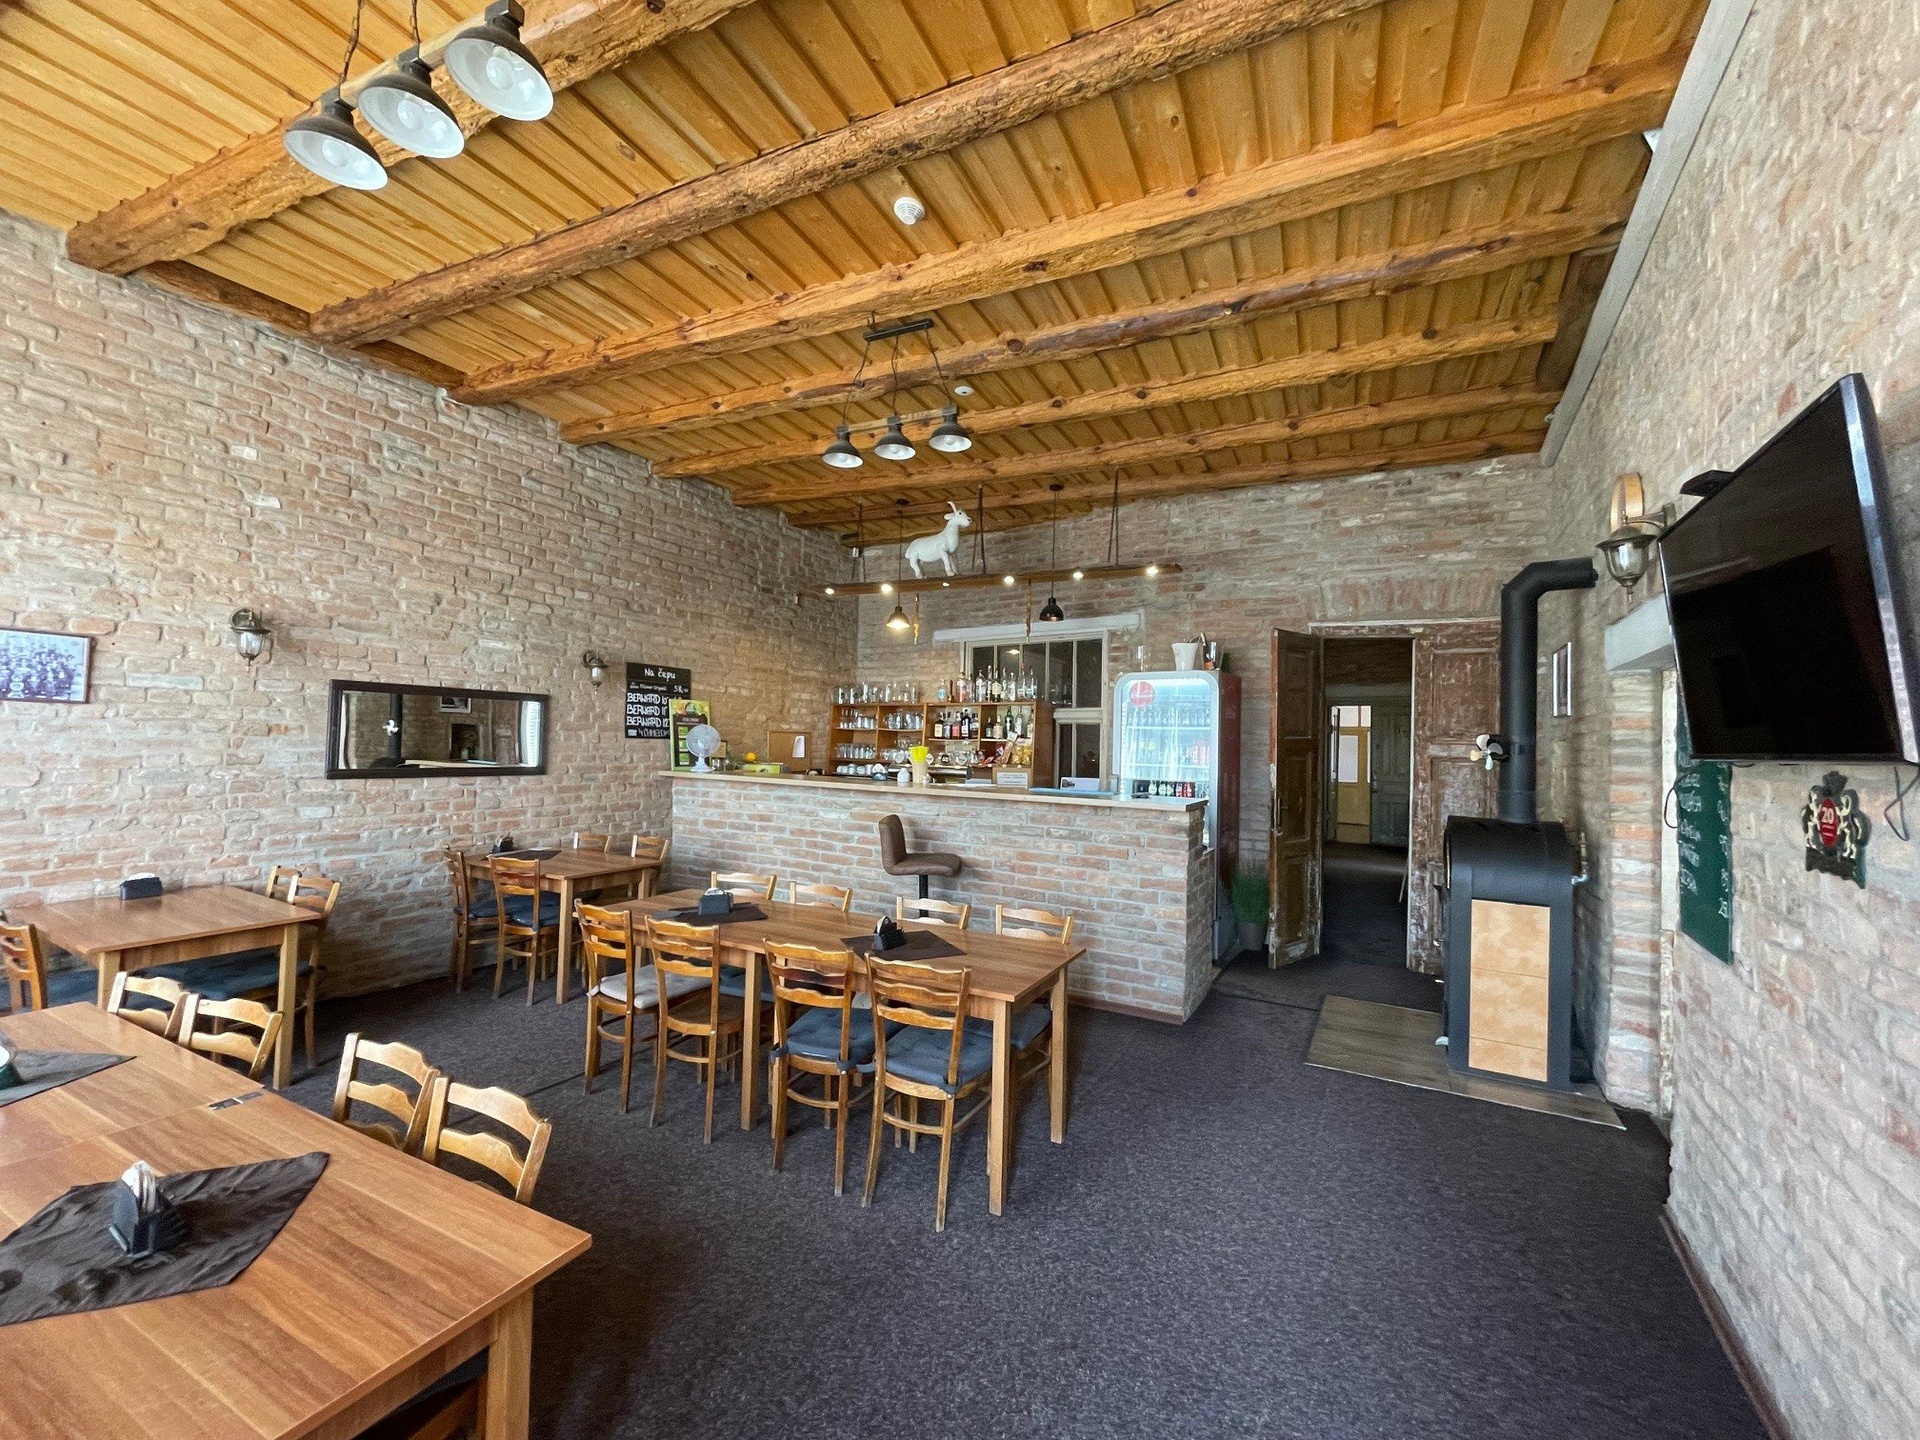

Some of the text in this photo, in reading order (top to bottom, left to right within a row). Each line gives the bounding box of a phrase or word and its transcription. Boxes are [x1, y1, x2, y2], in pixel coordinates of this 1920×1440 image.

[645, 667, 676, 681] Na čepu
[627, 693, 660, 704] BERNARD
[627, 704, 660, 716] BERNARD
[626, 716, 661, 727] BERNARD
[1822, 807, 1834, 824] 20
